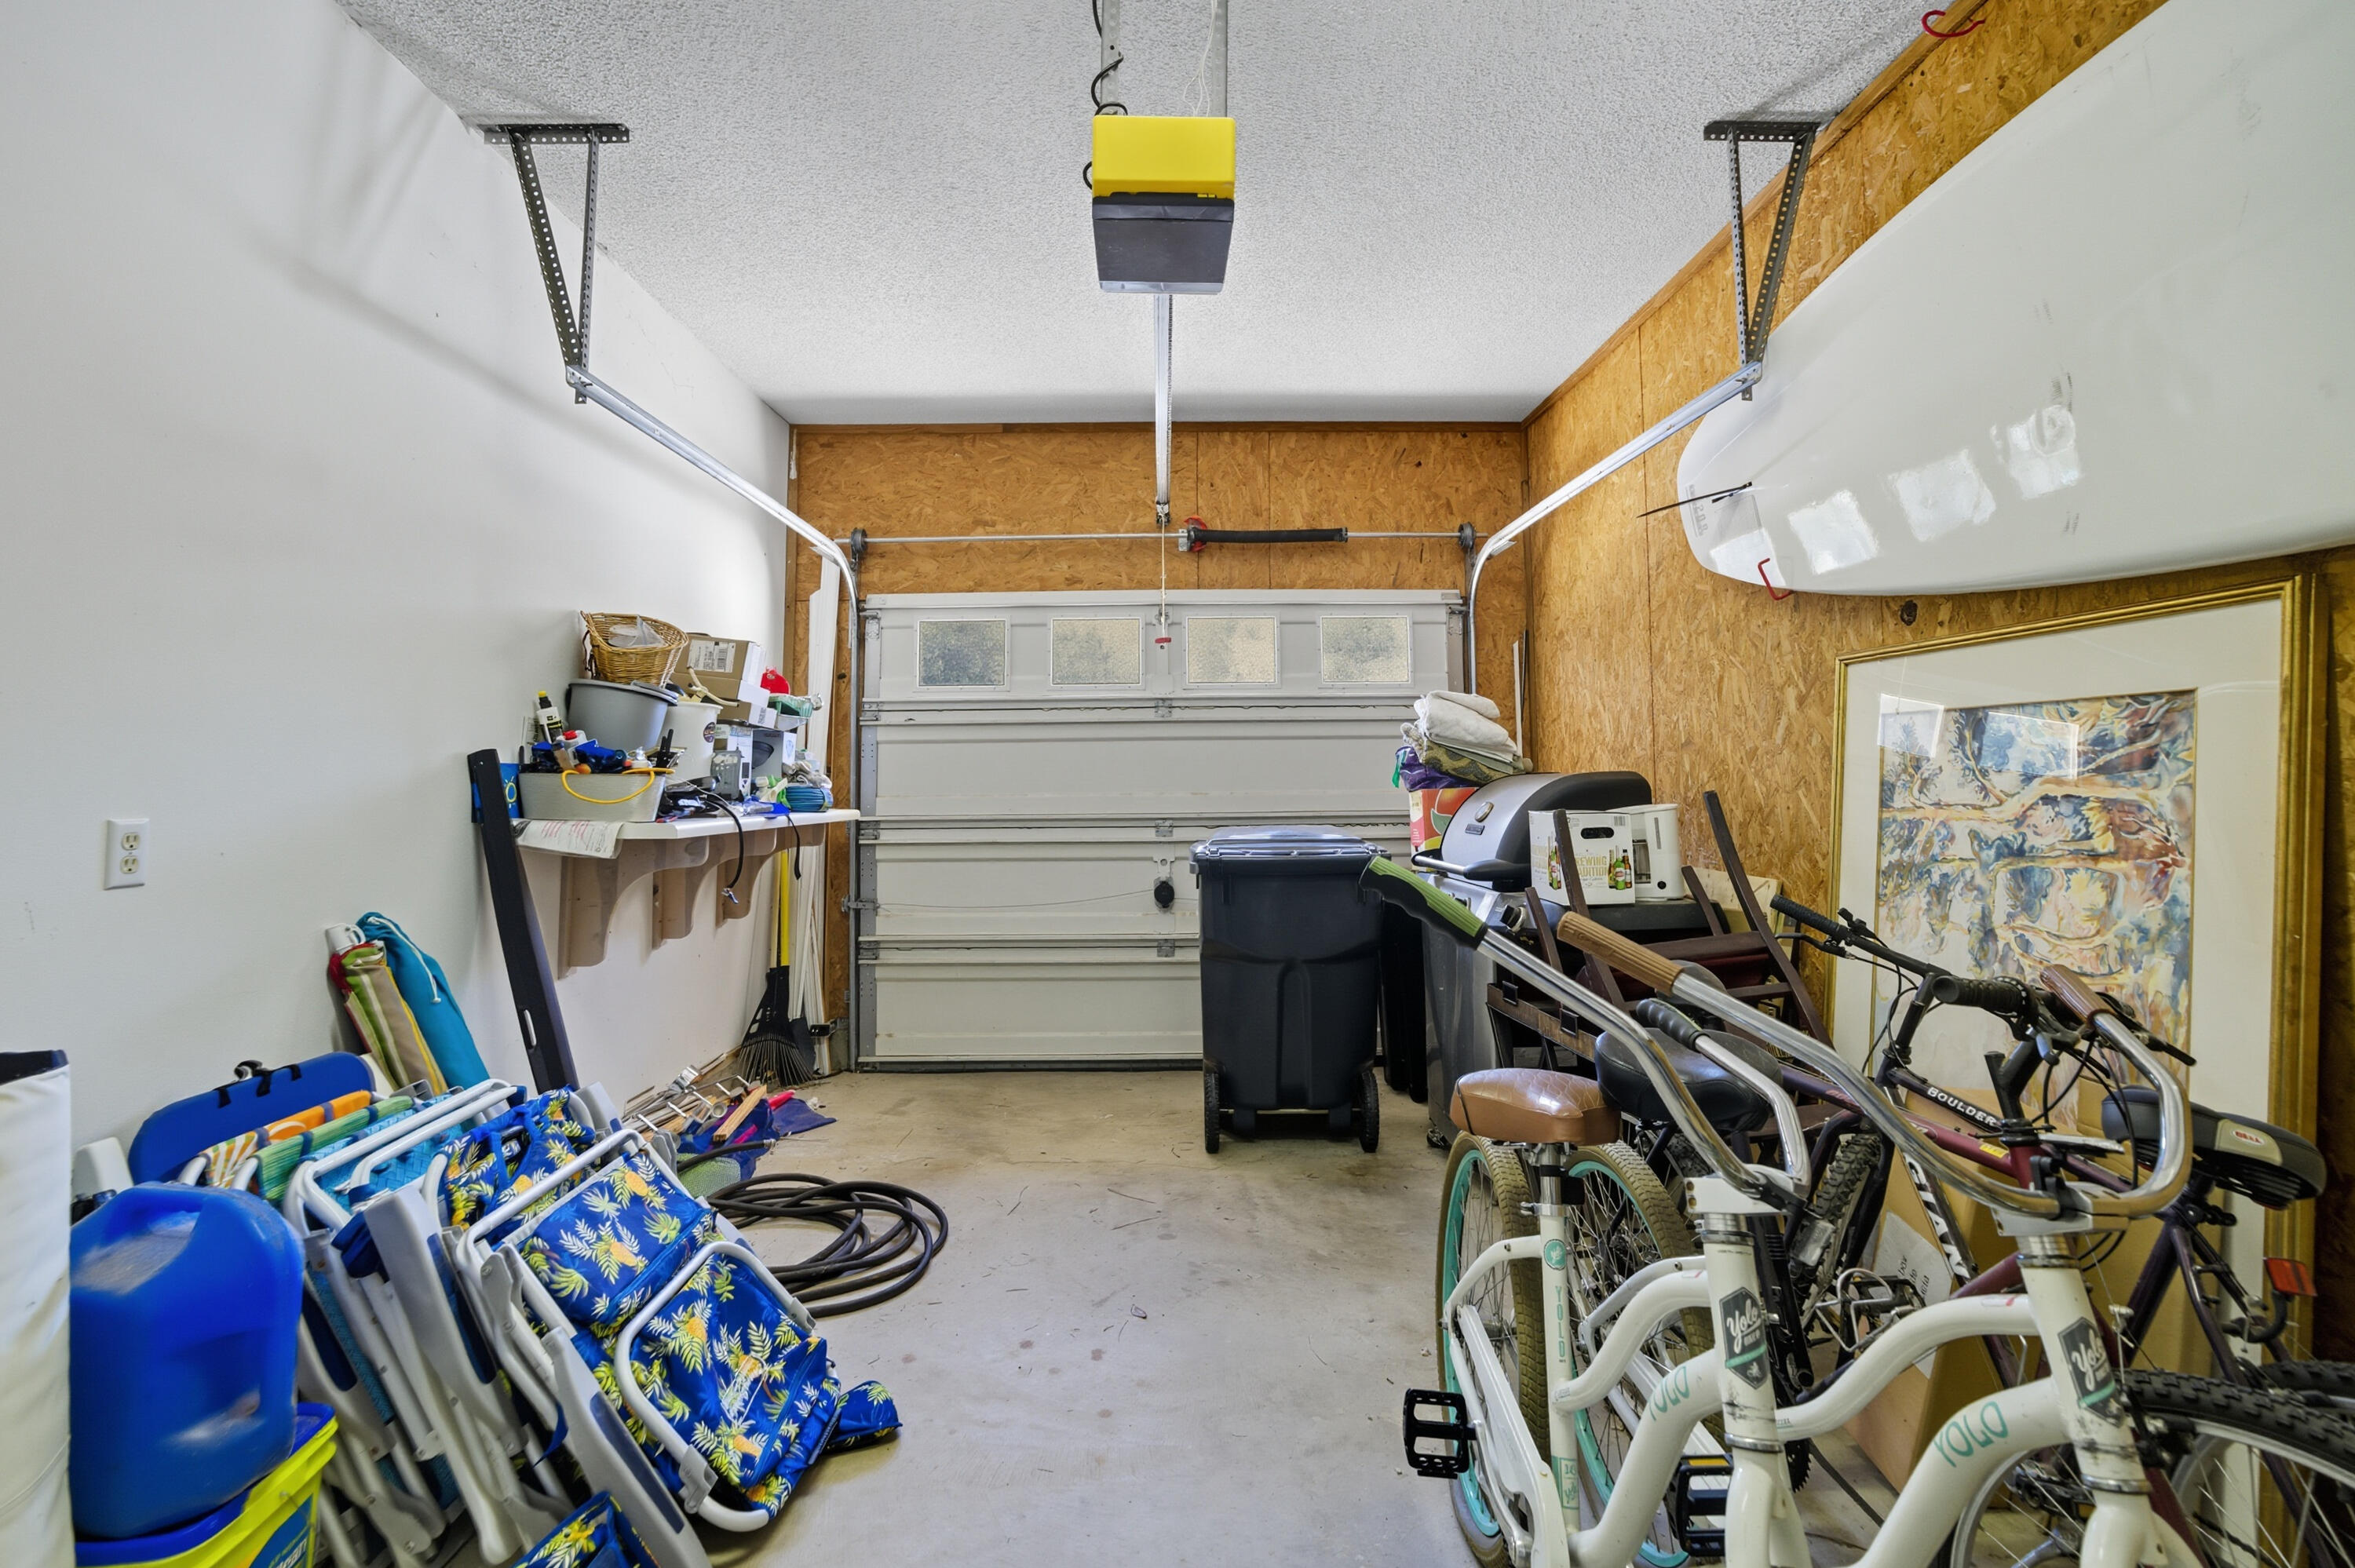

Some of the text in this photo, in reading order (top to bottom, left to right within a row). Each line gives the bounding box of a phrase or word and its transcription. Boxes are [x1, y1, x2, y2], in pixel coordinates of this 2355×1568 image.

[1927, 1087, 1997, 1126] BOULDER
[1554, 1285, 1565, 1358] YOLO
[1933, 1400, 2008, 1468] YOLO
